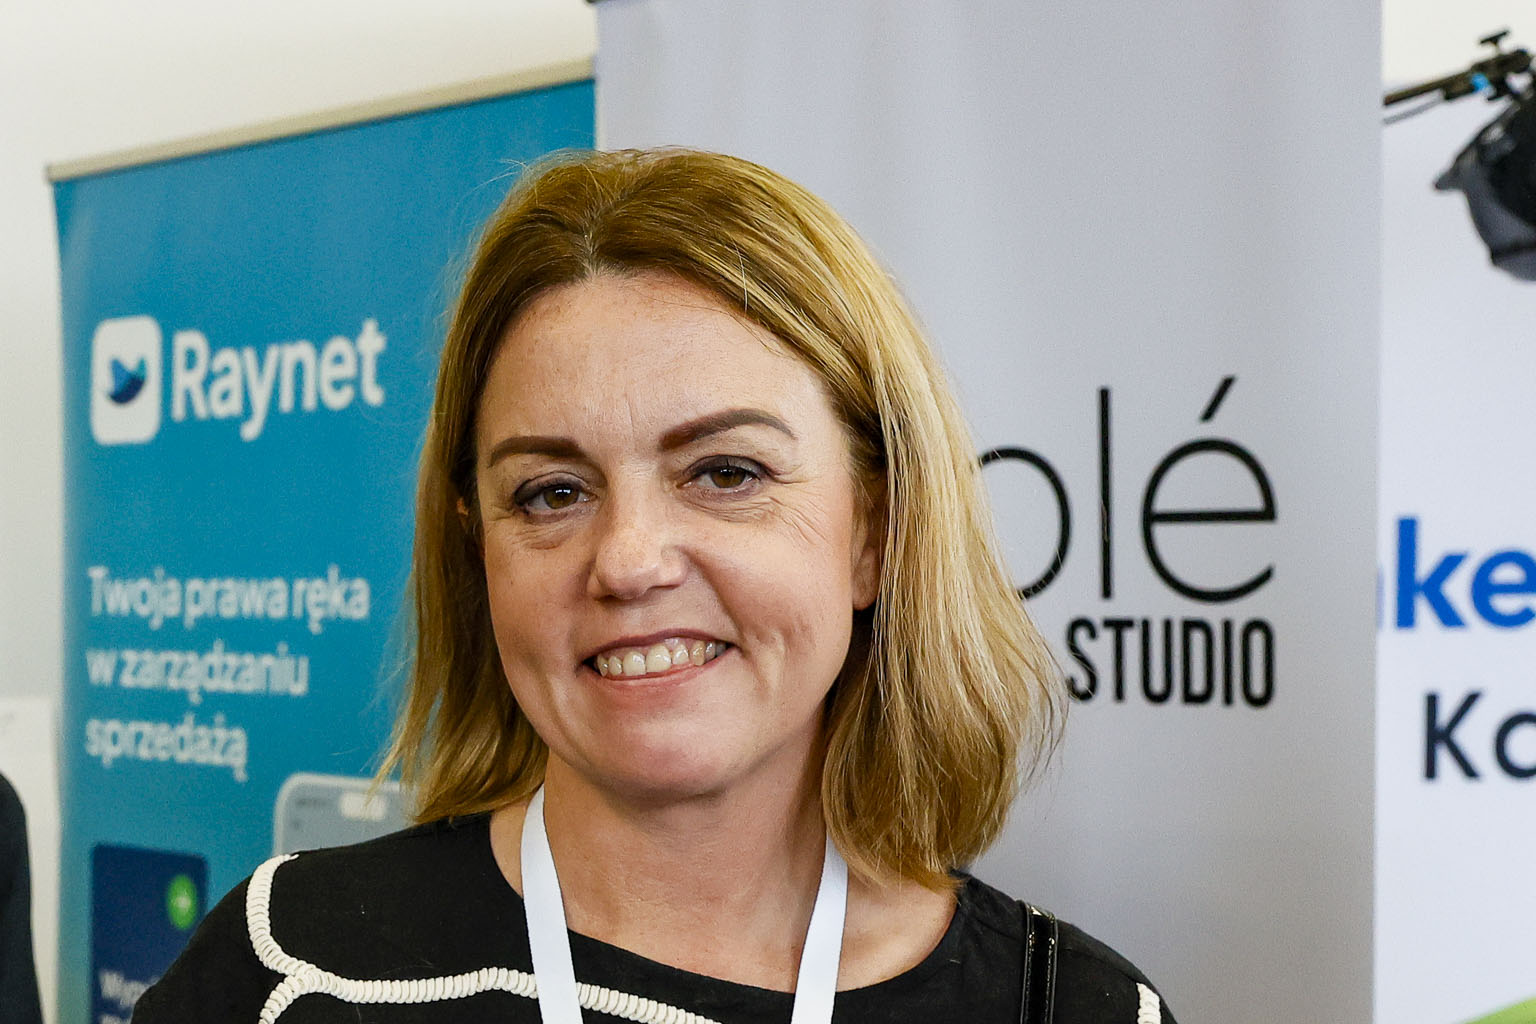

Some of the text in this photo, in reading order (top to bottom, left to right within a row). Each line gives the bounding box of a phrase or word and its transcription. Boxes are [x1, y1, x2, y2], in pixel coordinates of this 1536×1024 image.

[171, 317, 387, 442] Raynet
[87, 563, 371, 636] Twoja prawa ręka
[1377, 515, 1536, 632] ke
[86, 637, 311, 705] w zarządzaniu
[1066, 616, 1277, 709] STUDIO
[85, 710, 249, 783] sprzedażą
